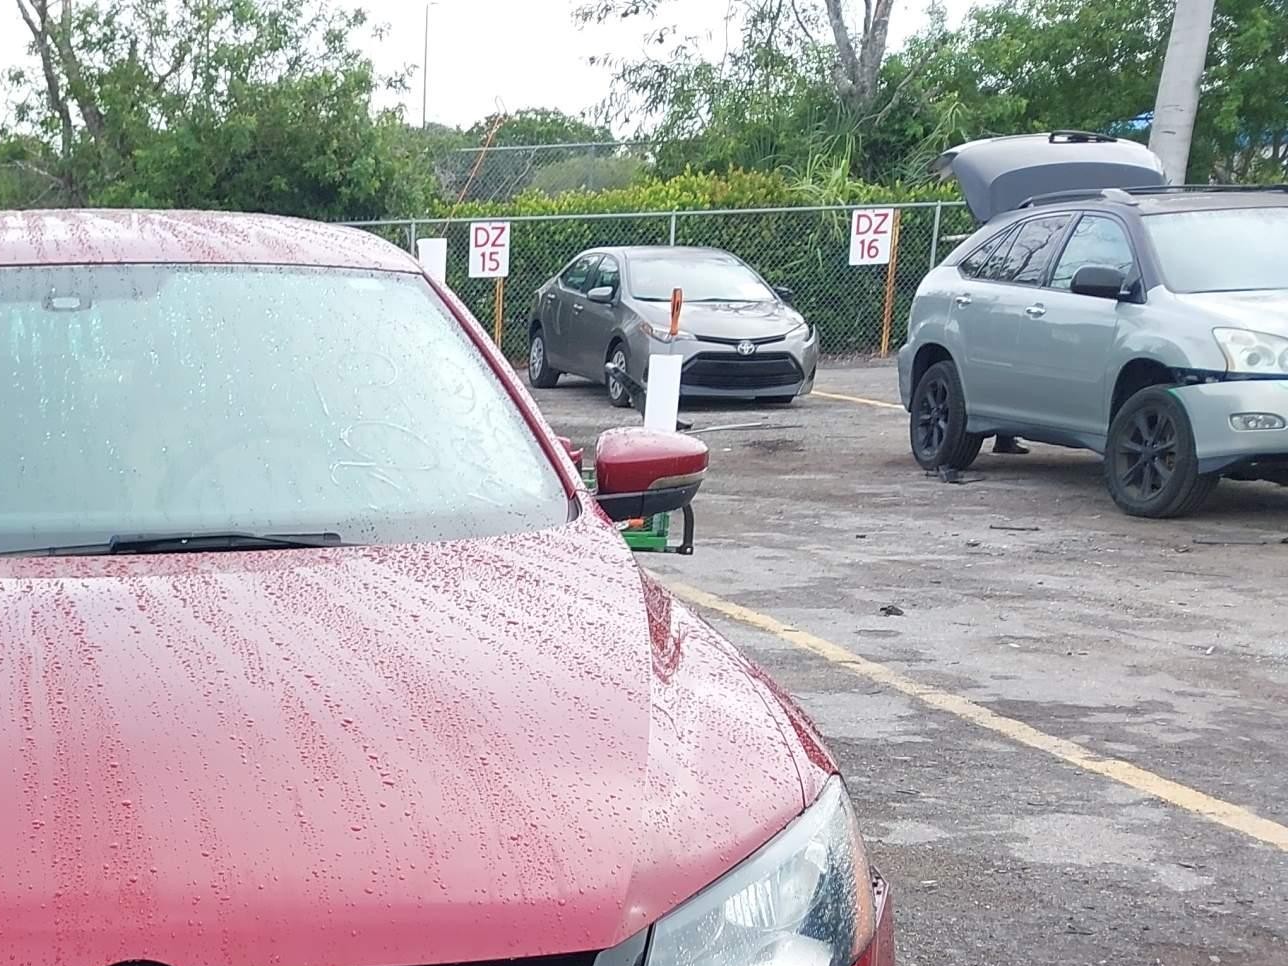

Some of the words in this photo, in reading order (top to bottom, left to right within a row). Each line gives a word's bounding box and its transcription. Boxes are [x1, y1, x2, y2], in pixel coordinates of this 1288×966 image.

[855, 213, 889, 235] DZ
[474, 226, 506, 248] DZ
[859, 239, 879, 260] 16
[480, 251, 500, 272] 15
